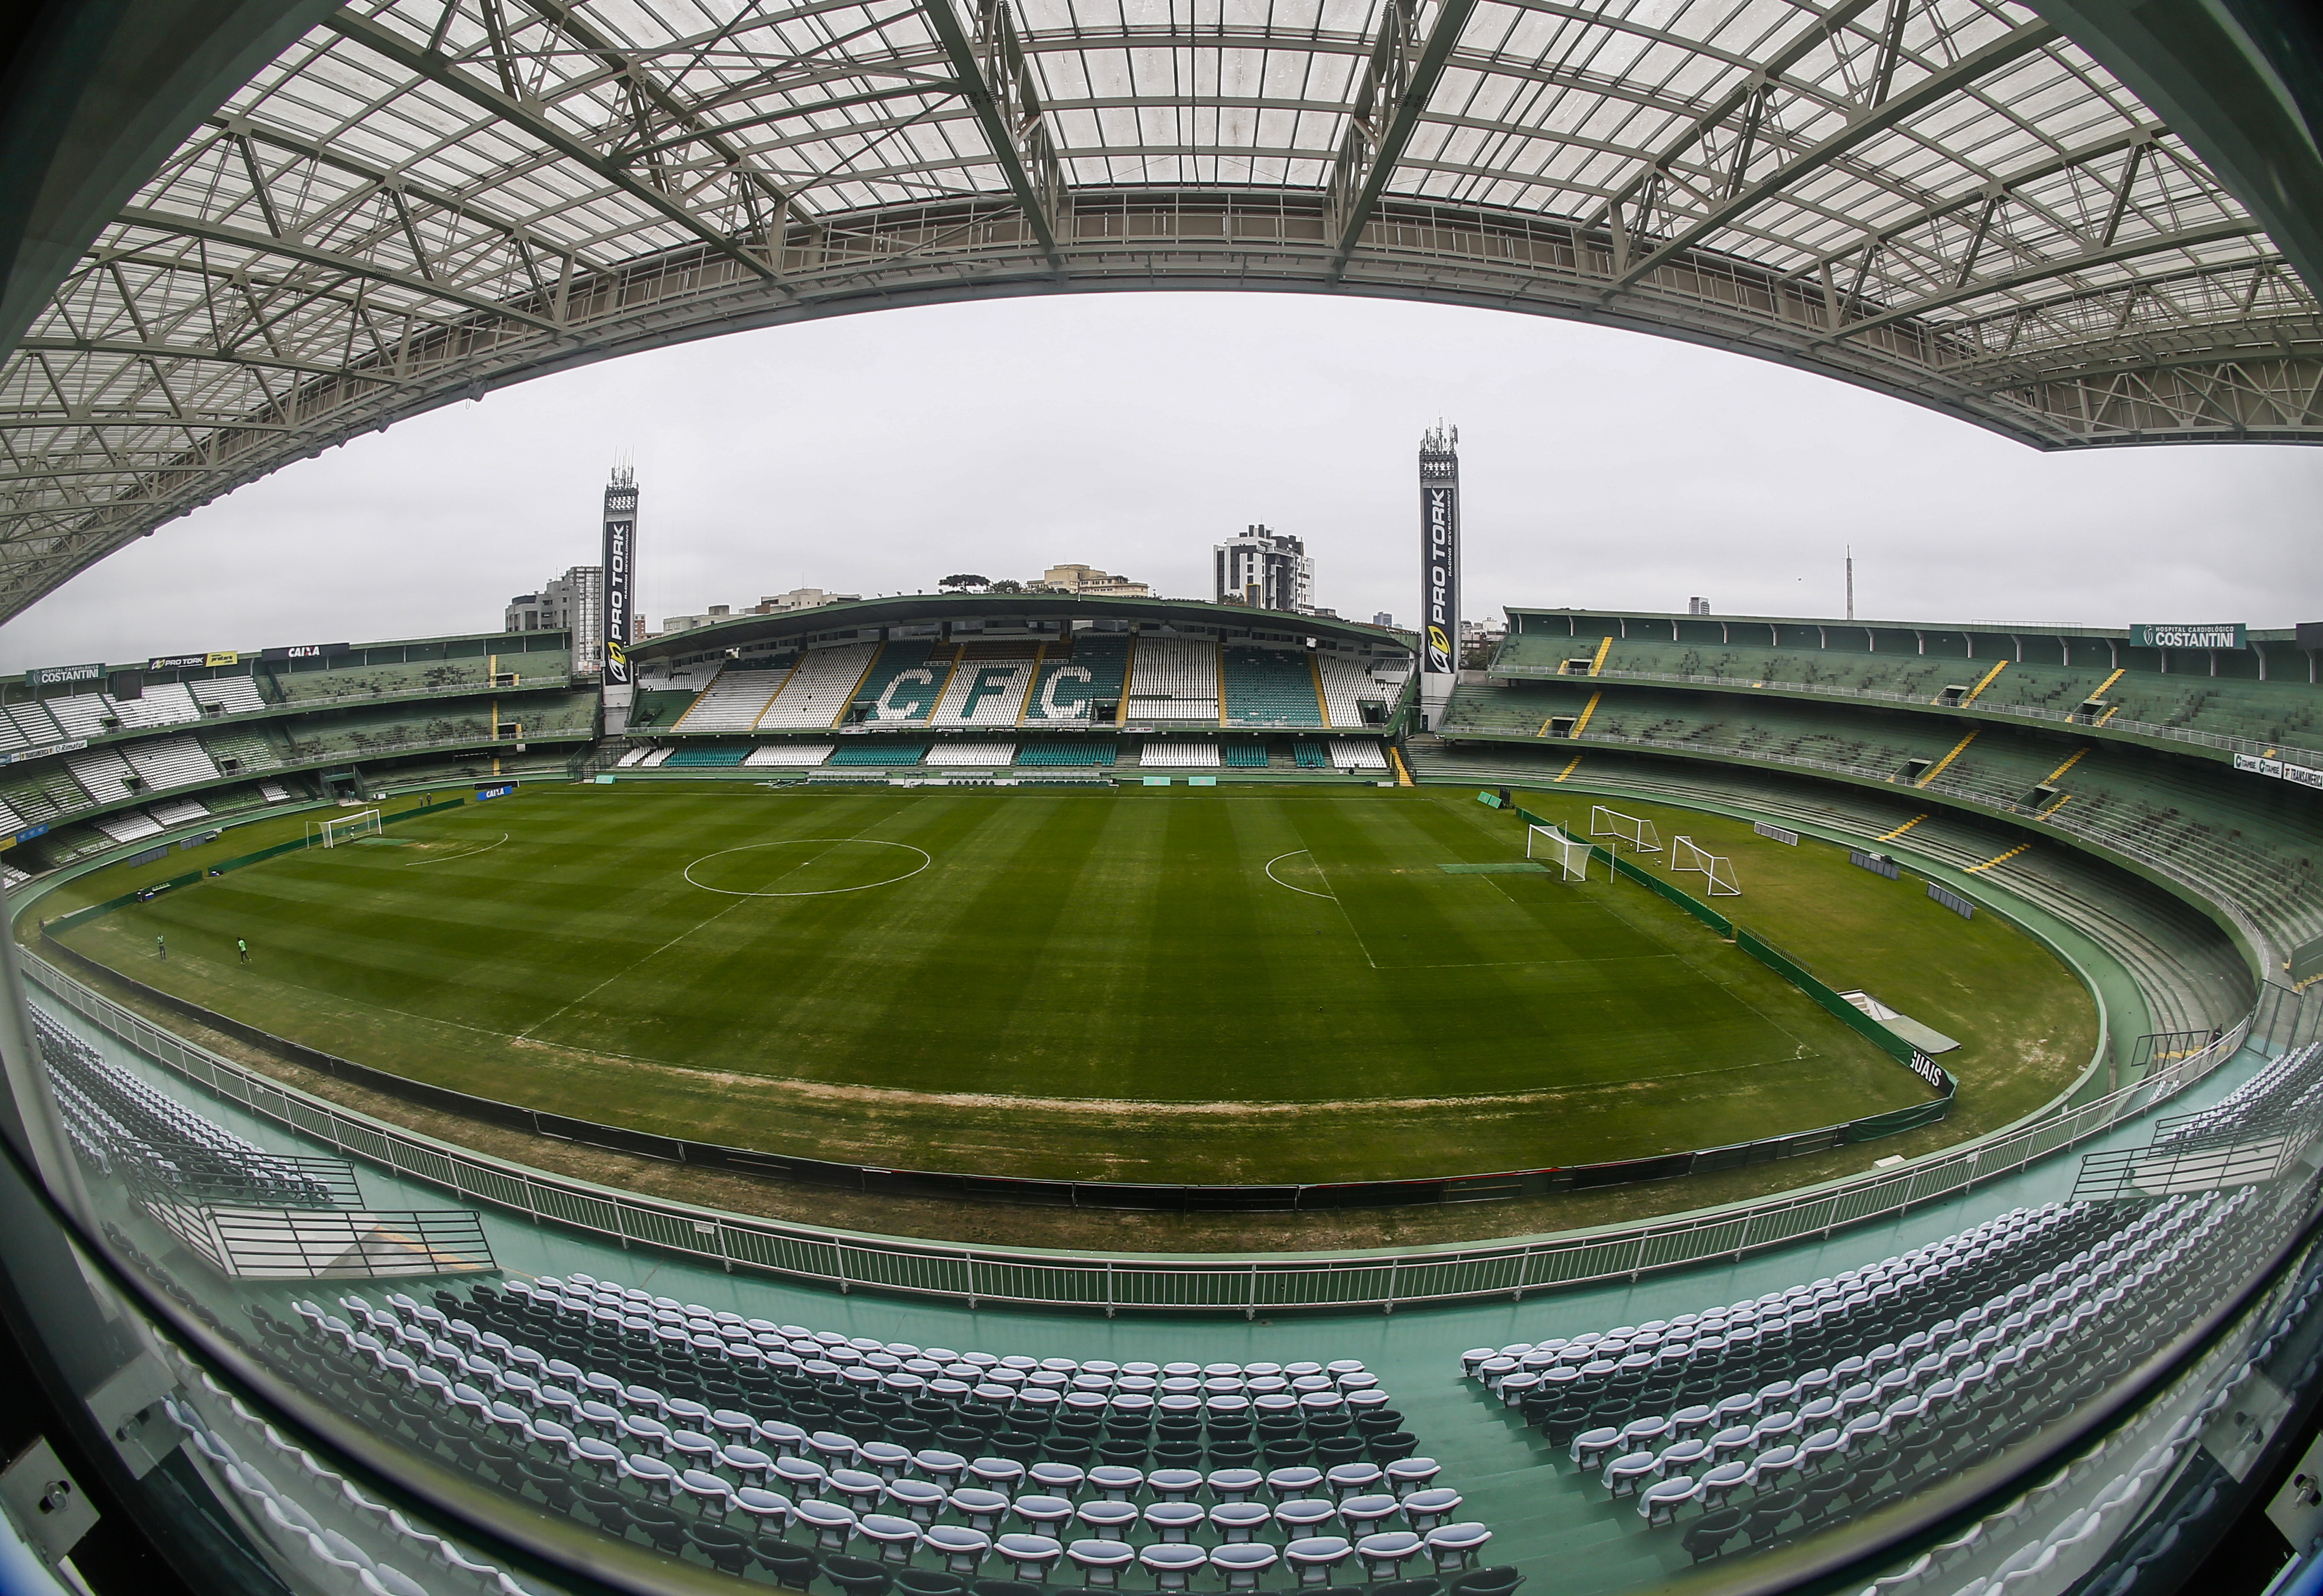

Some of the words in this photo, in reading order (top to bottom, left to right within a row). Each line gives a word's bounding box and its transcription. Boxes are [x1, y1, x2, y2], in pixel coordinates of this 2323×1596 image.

[1432, 489, 1445, 561] TORK
[612, 523, 624, 587] TORK
[1433, 566, 1446, 625] PRO
[611, 591, 623, 640] PRO
[2156, 632, 2234, 647] COSTANTINI
[288, 646, 320, 657] CAIXA
[41, 669, 99, 683] COSTANTINI
[61, 741, 86, 751] Rimatur
[486, 787, 504, 798] CAIXA
